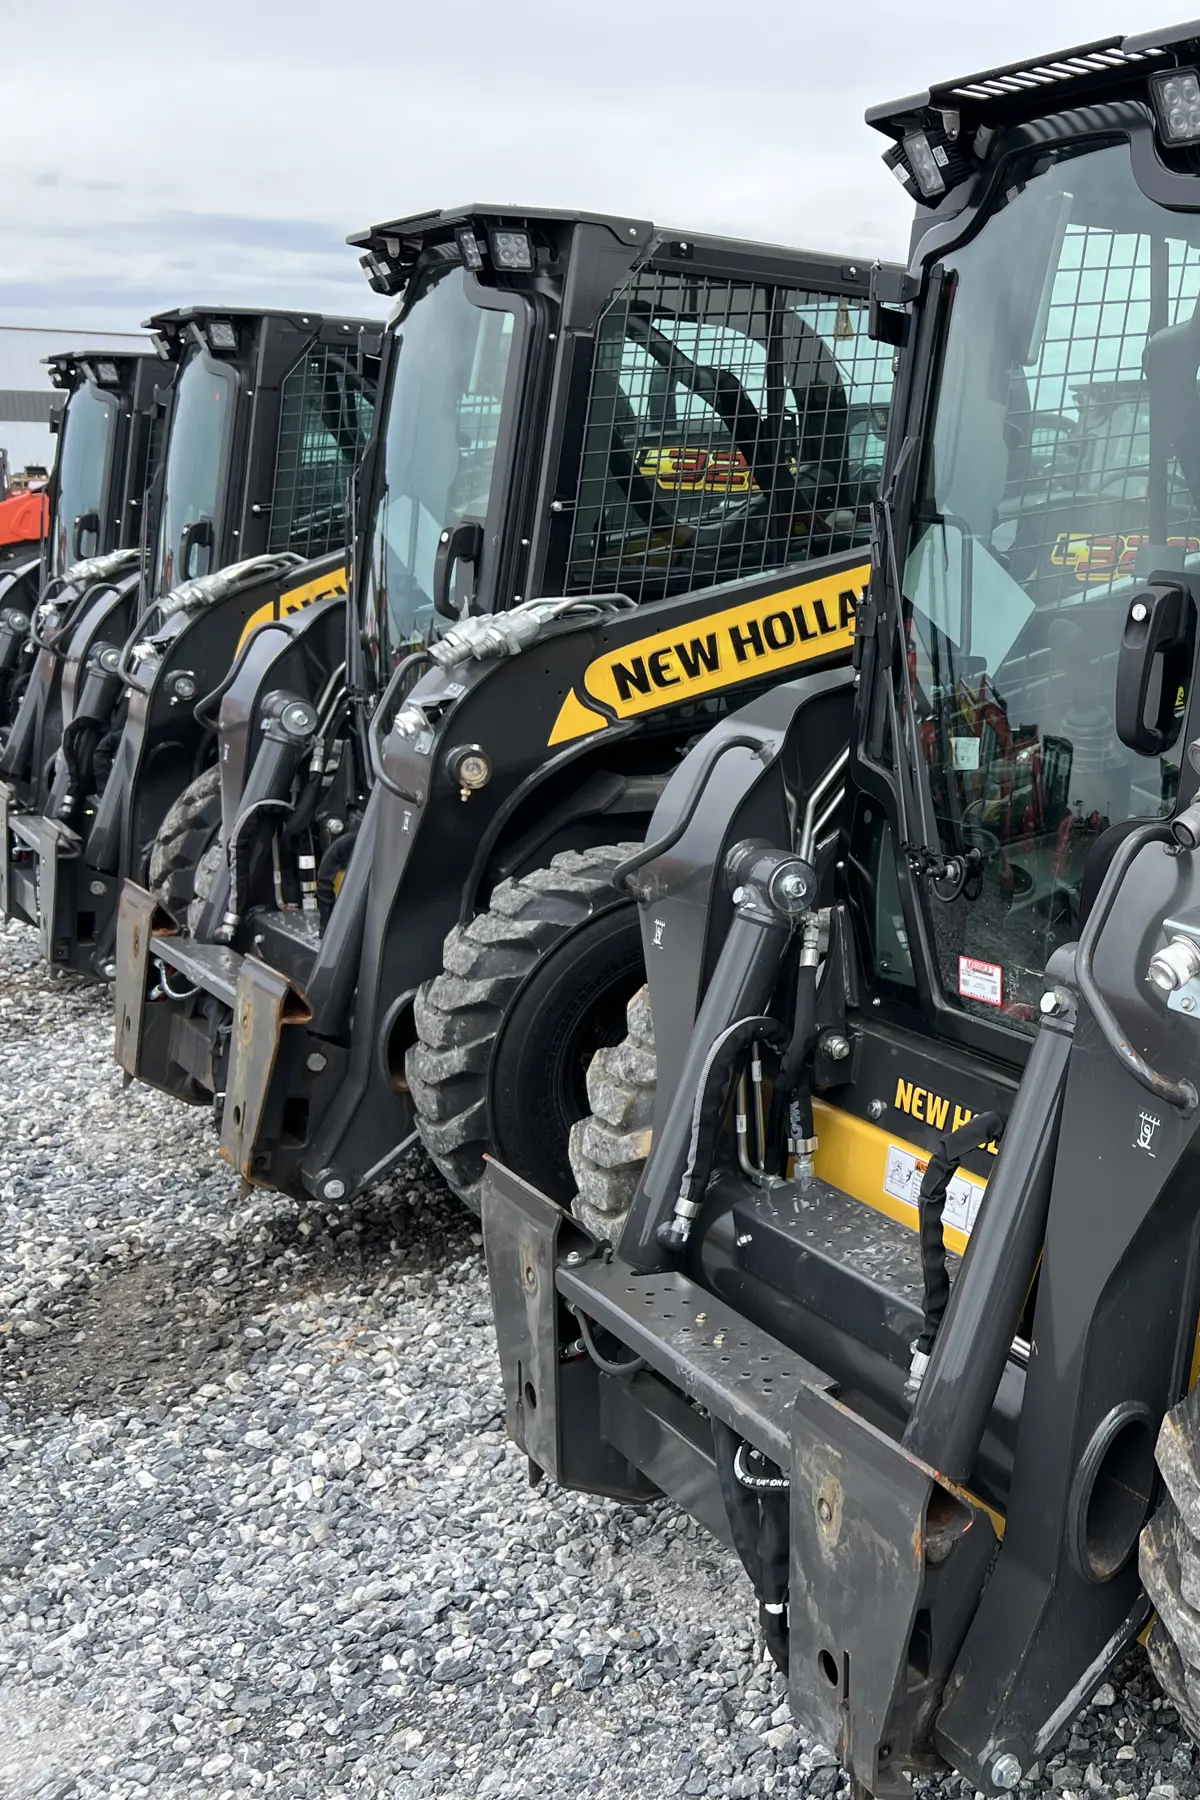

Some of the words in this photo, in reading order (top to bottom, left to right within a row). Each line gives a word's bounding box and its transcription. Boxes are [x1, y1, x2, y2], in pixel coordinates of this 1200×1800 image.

[635, 447, 762, 492] L32
[610, 631, 721, 703] NEW
[728, 584, 869, 664] HOLLA
[894, 1077, 950, 1131] NEW
